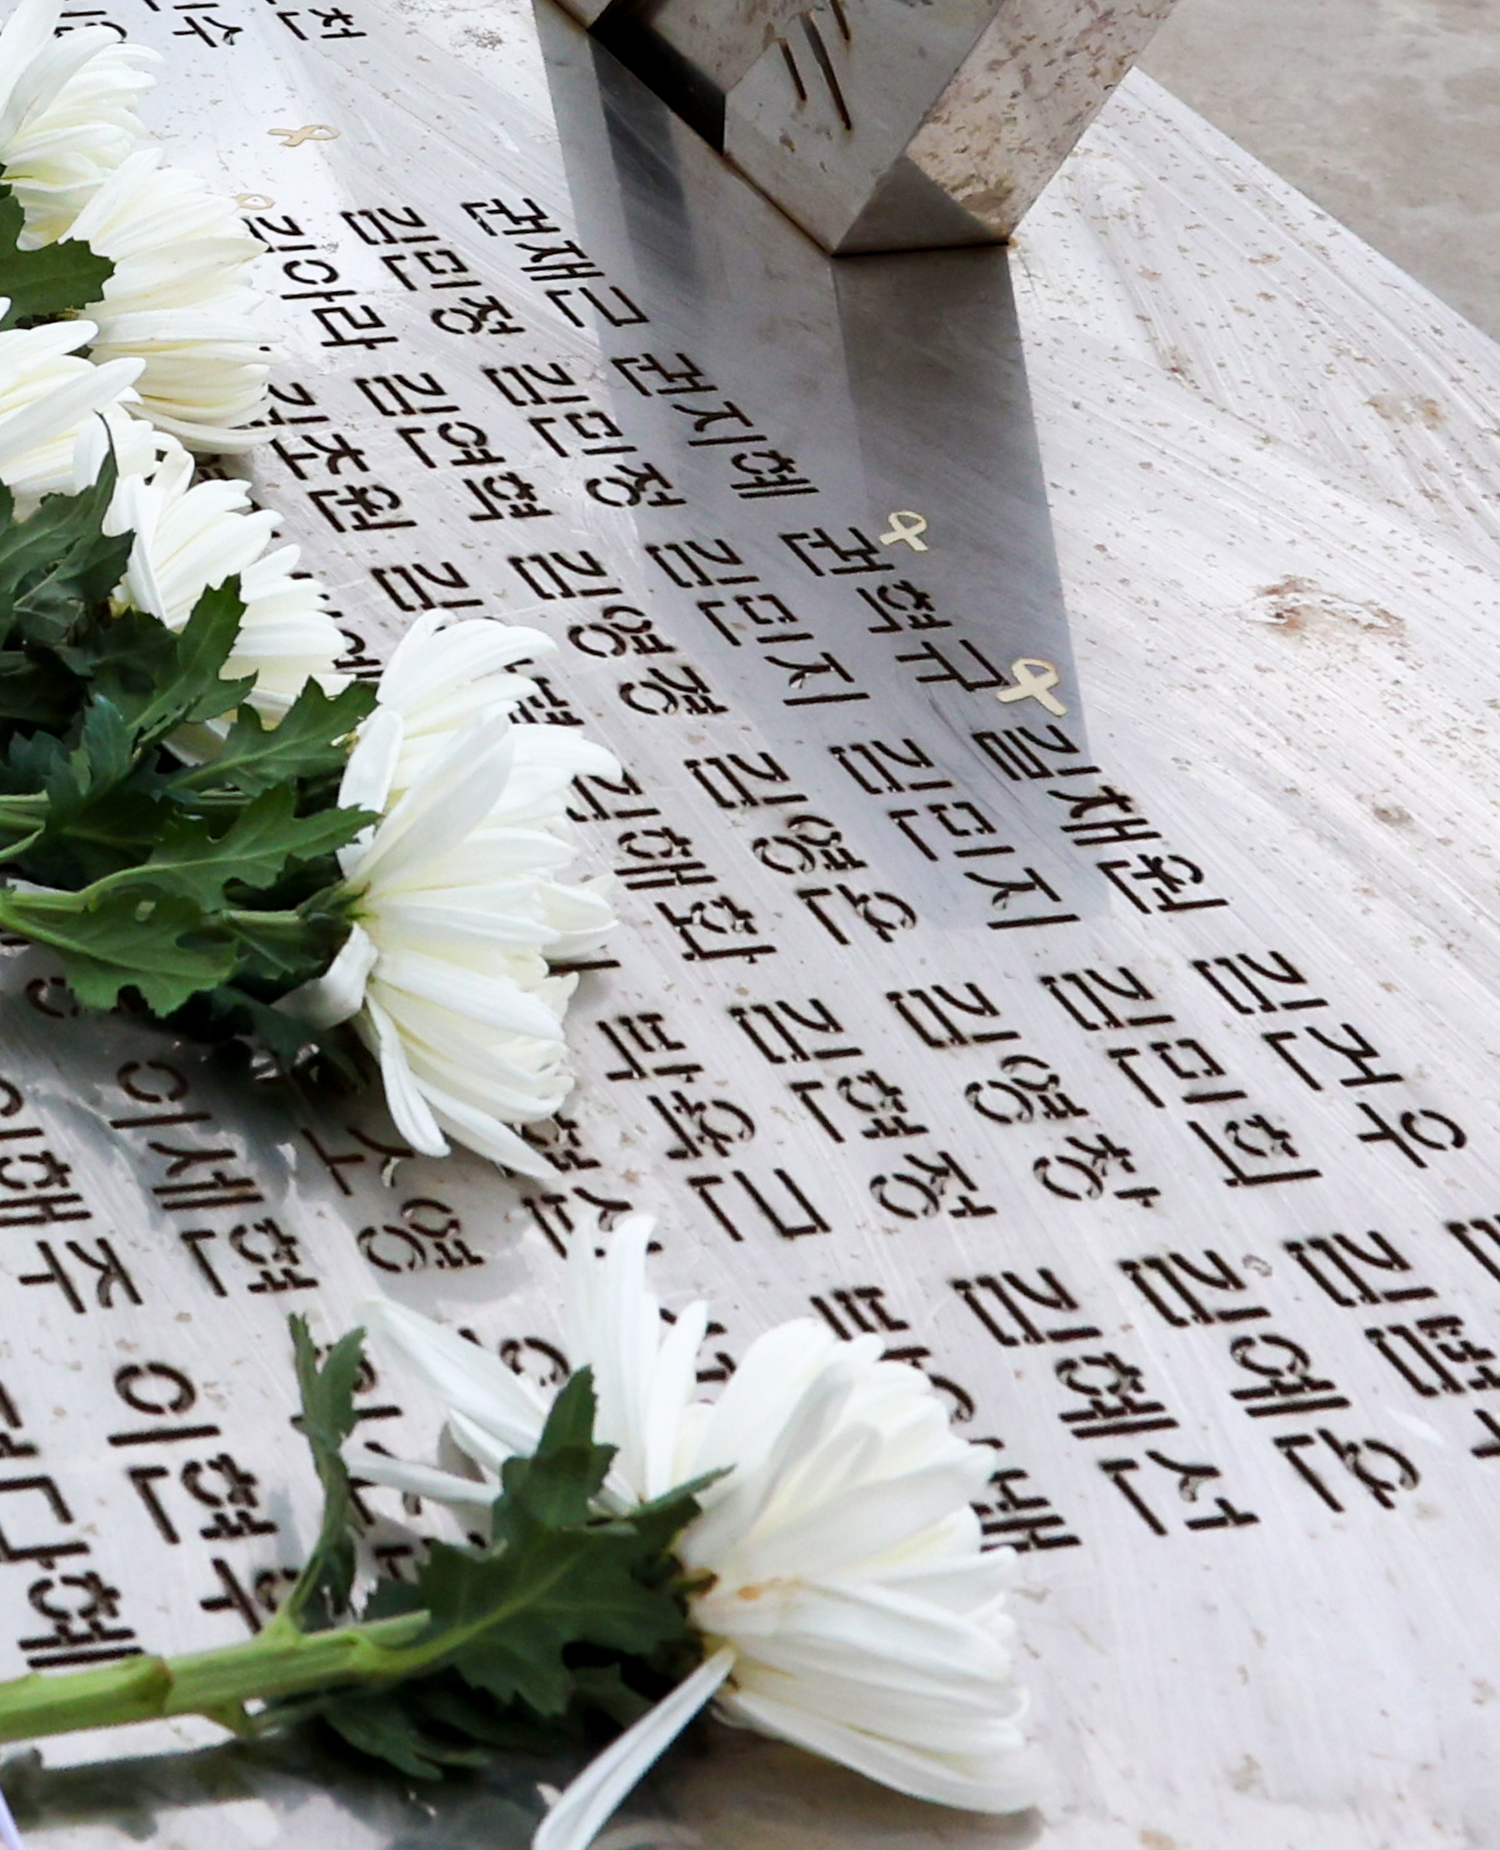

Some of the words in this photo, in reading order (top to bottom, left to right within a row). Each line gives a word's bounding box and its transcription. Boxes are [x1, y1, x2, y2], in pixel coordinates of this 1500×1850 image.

[211, 212, 412, 352] 김아라
[351, 371, 555, 522] 김연혁
[506, 549, 729, 716] 김영경
[683, 751, 917, 946] 김영은
[884, 981, 1161, 1209] 김영창
[1115, 1249, 1420, 1513] 김예은
[338, 205, 526, 335] 김민정
[479, 362, 687, 507] 김민정
[643, 537, 870, 707] 김민지
[826, 737, 1081, 930] 김민지
[1037, 965, 1322, 1187] 김민희
[459, 197, 650, 328] 권재근
[609, 351, 820, 499] 권지혜
[777, 526, 1011, 692] 권혁규
[969, 723, 1229, 915] 길채원
[1189, 950, 1467, 1169] 김건우
[108, 1058, 319, 1297] 이세현
[594, 1011, 832, 1242] 박육근
[725, 997, 997, 1220] 김현정
[947, 1266, 1260, 1536] 김혜선
